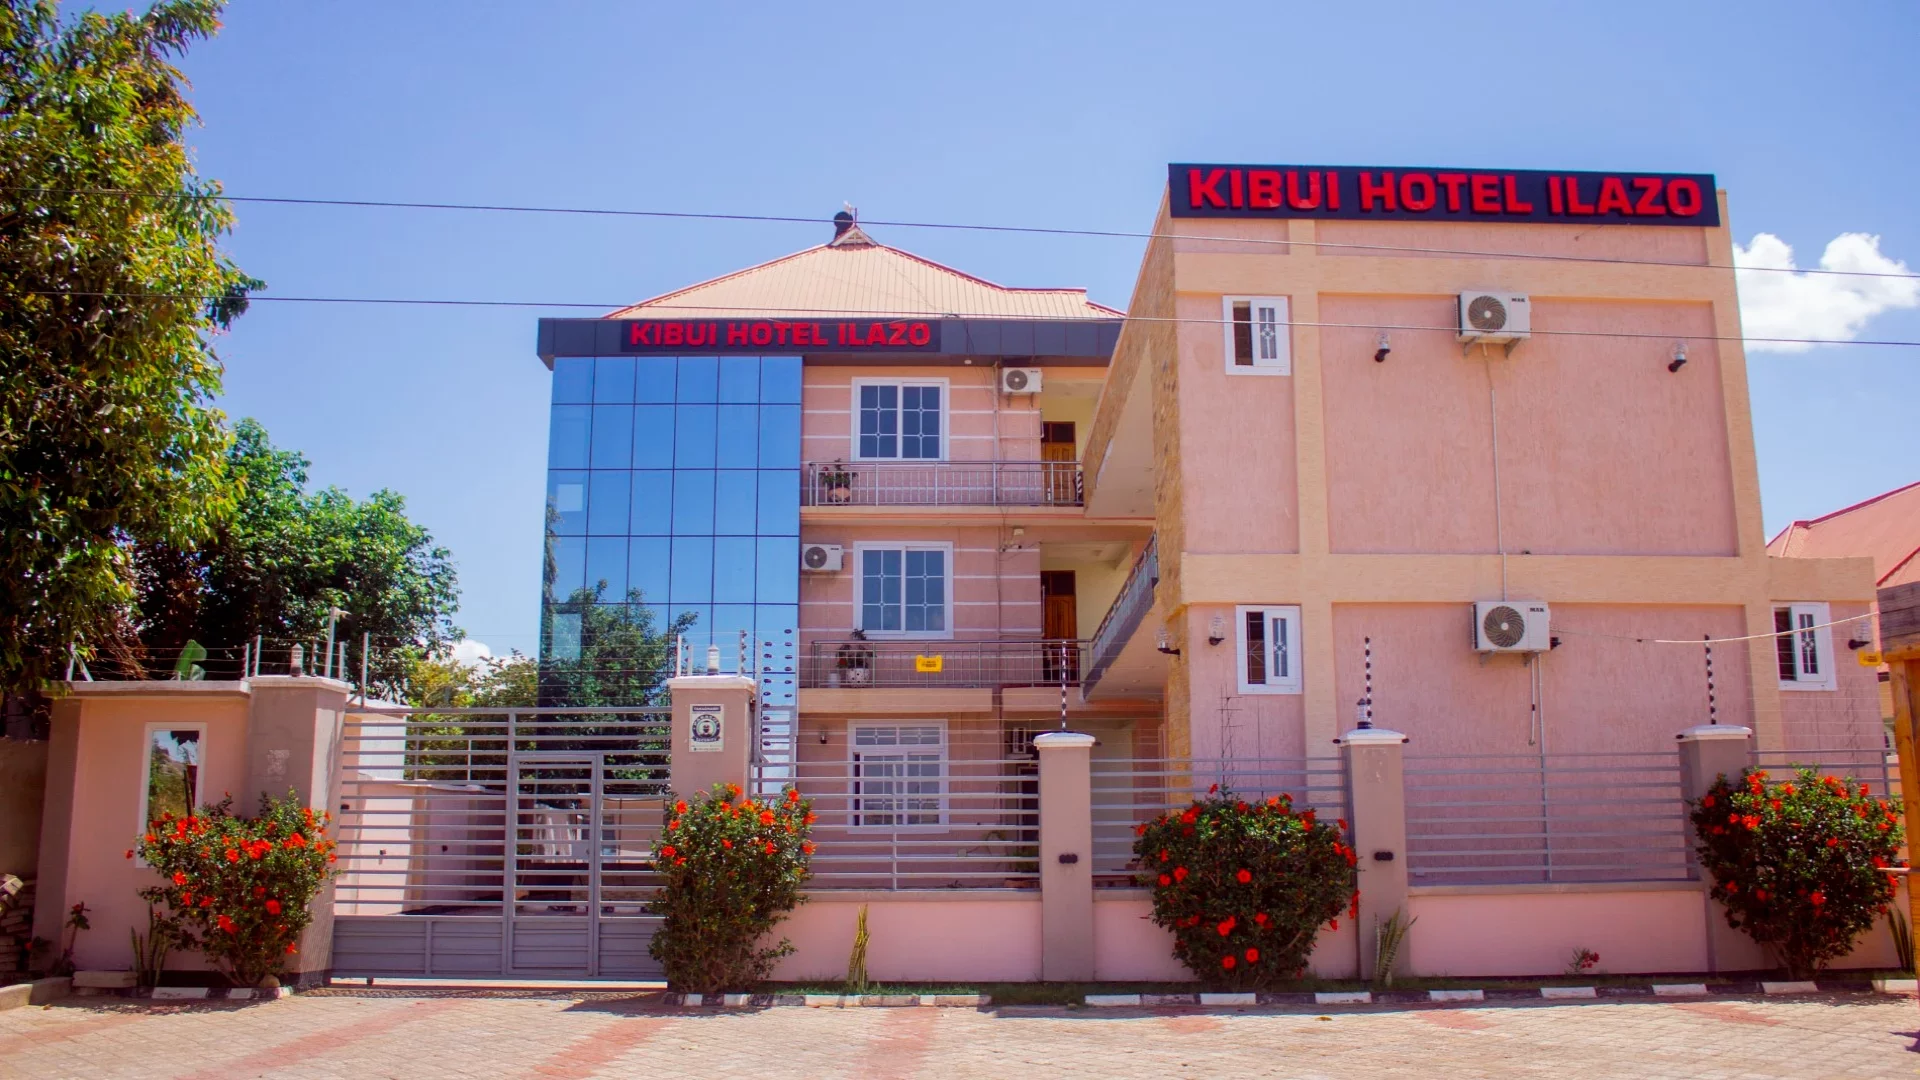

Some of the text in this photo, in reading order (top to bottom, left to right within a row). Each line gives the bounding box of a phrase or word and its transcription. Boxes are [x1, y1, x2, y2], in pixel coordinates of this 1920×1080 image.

[1188, 168, 1704, 217] KIBUI HOTEL ILAZO
[630, 322, 932, 346] KIBUI HOTEL ILAZO
